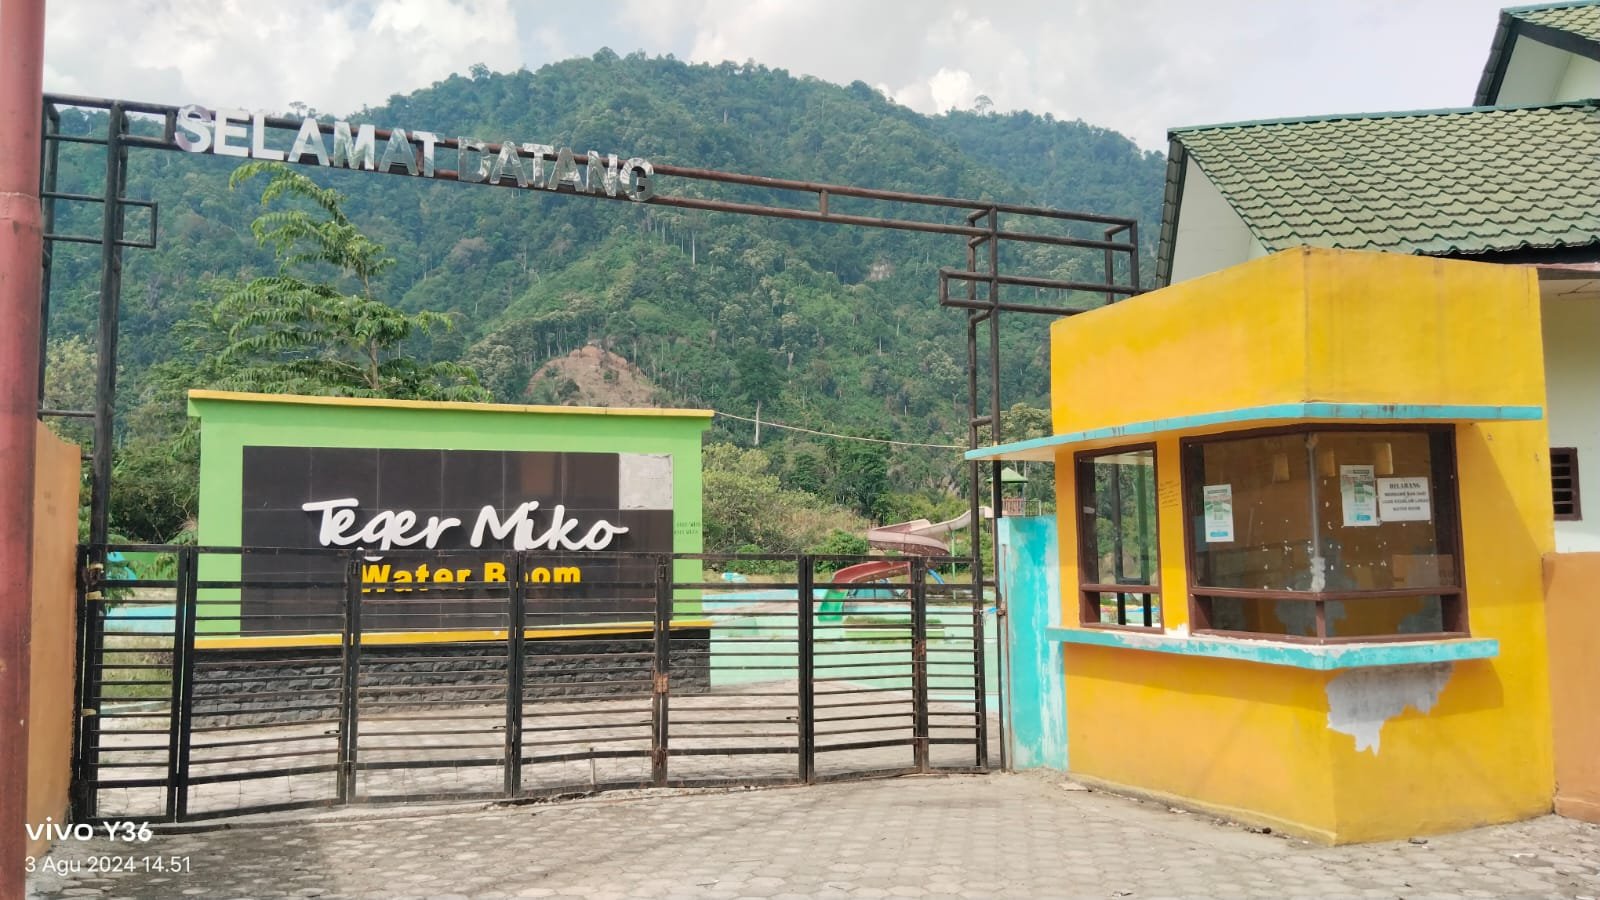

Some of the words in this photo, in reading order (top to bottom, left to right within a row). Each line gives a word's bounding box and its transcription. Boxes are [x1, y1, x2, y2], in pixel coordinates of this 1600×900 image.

[174, 104, 444, 178] SELAMAT
[458, 136, 654, 201] DATANG
[302, 498, 462, 561] Teger
[470, 500, 629, 550] Miko
[362, 563, 471, 592] Water
[484, 561, 581, 588] Bom
